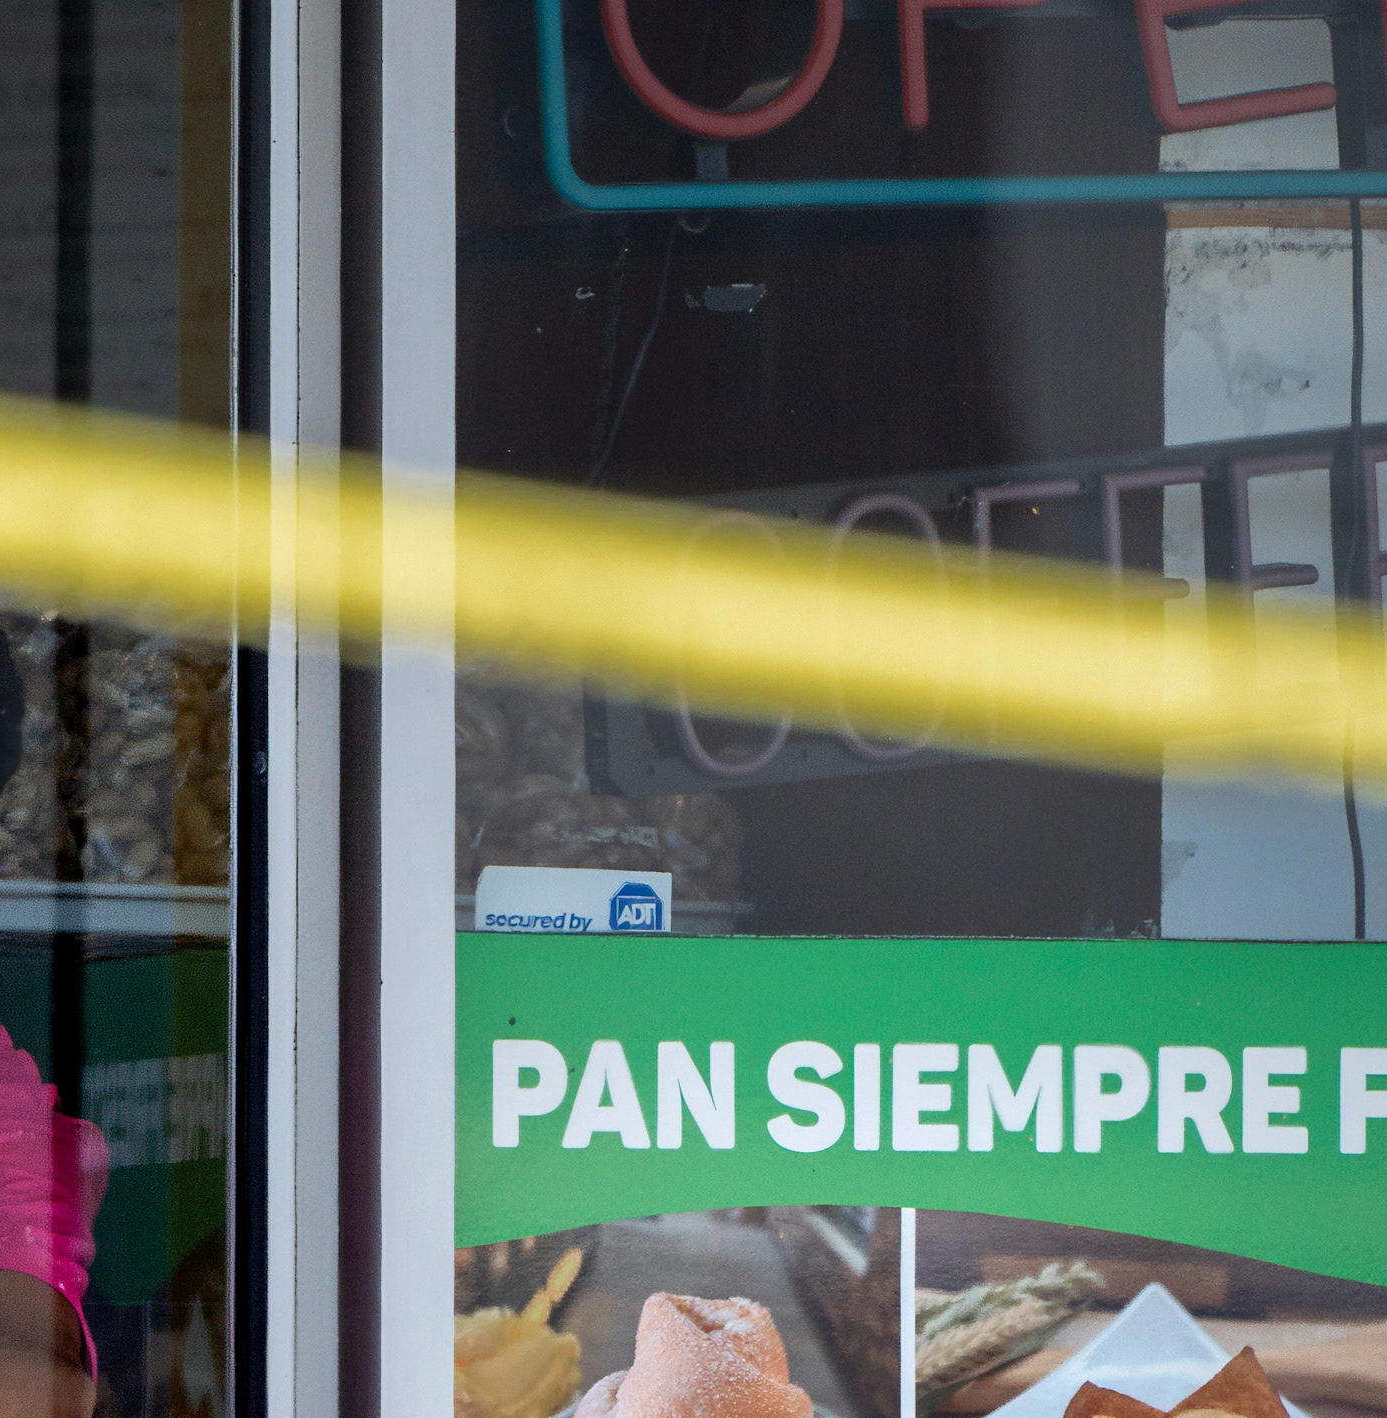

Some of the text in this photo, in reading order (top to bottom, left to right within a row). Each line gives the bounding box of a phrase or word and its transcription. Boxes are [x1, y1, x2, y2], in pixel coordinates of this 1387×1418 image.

[676, 445, 1387, 775] COFFE
[485, 902, 658, 932] secured by ADT
[492, 1039, 736, 1150] PAN
[767, 1041, 1309, 1154] SIEMPRE
